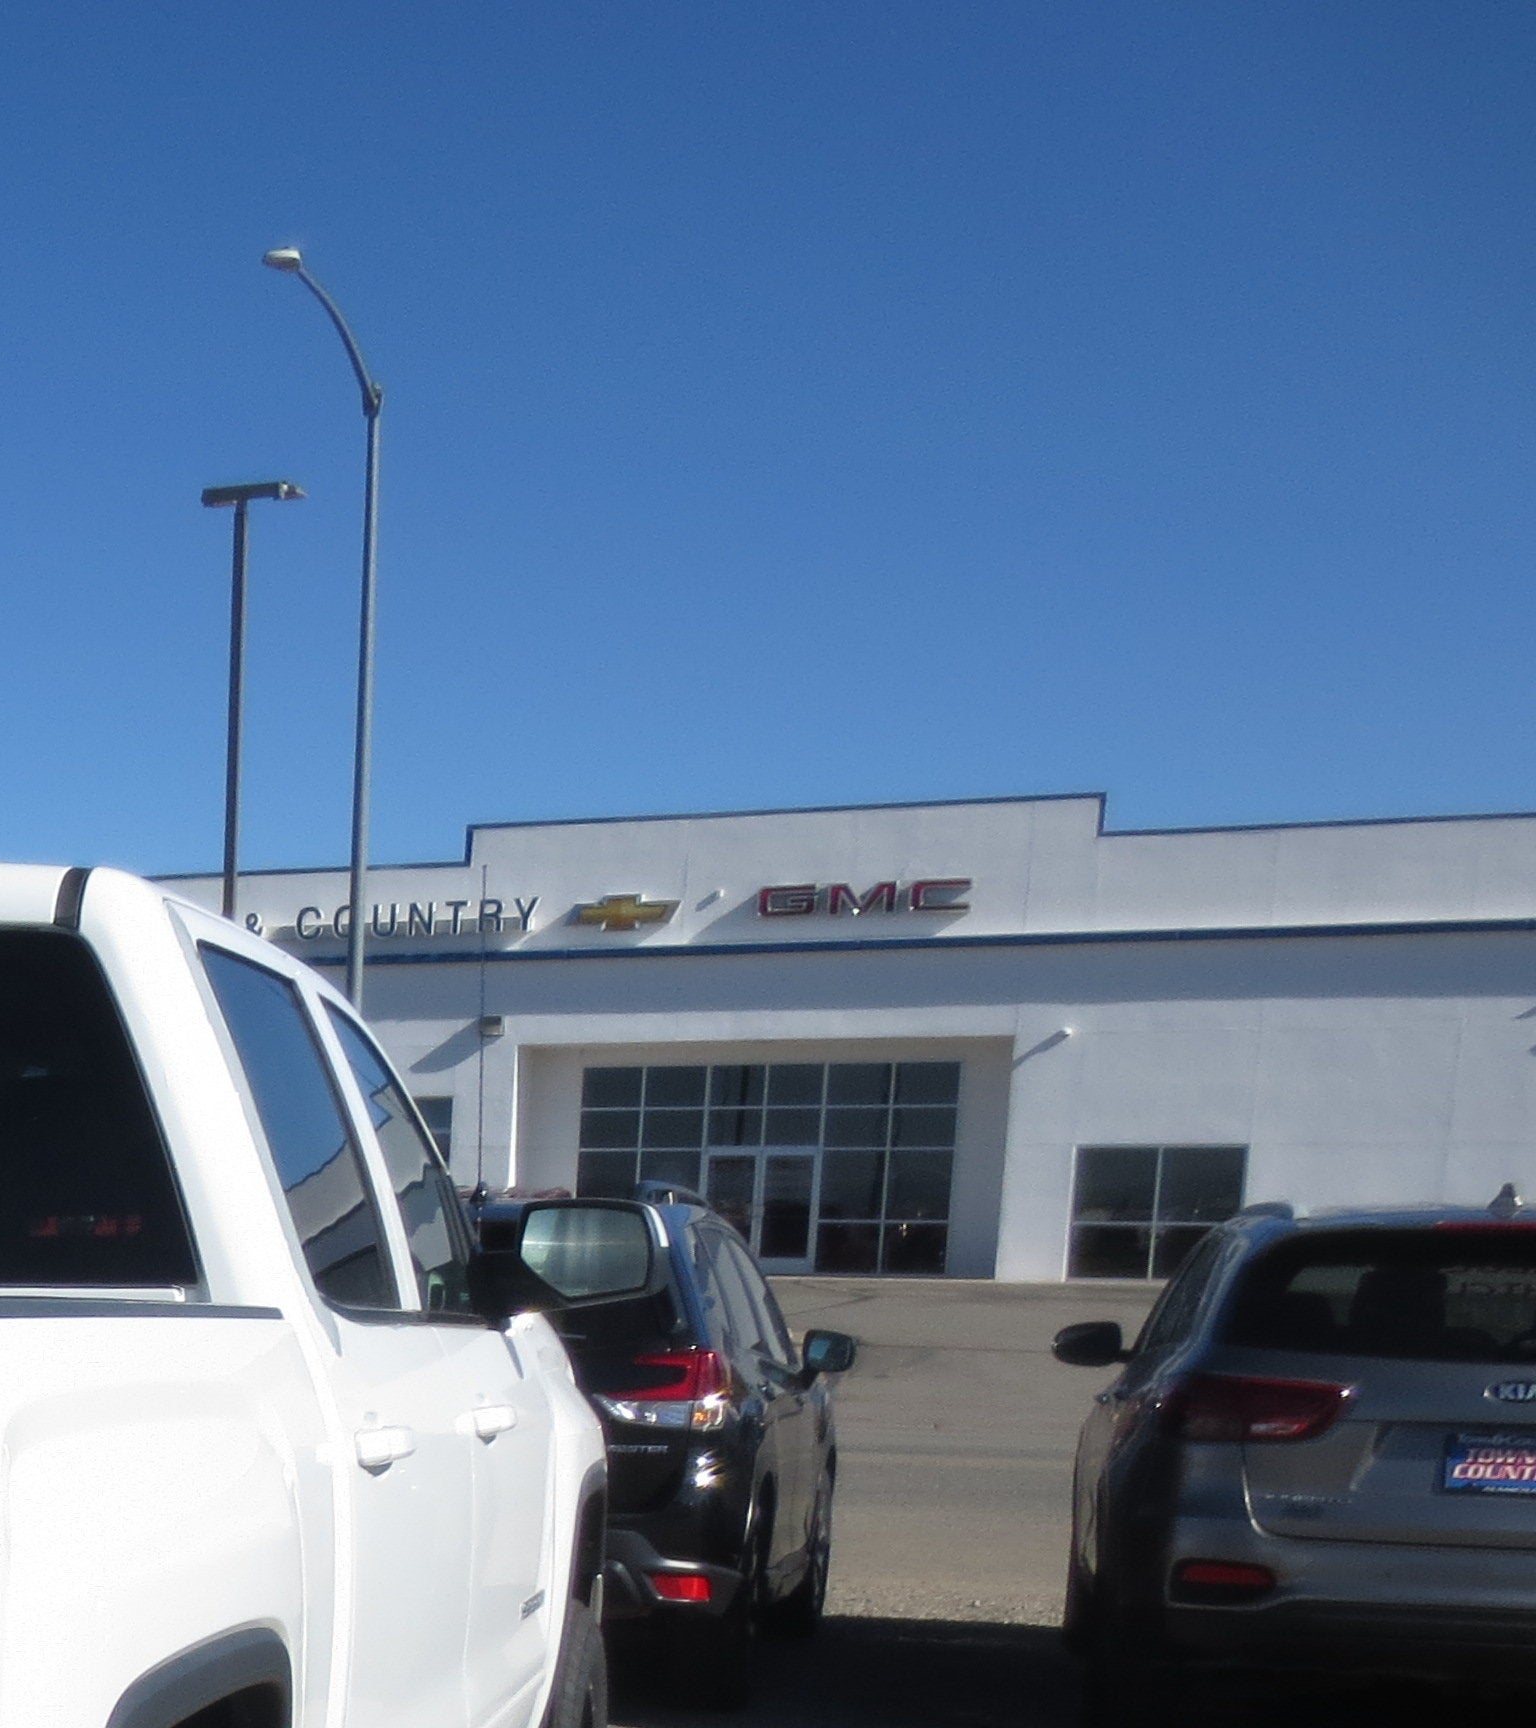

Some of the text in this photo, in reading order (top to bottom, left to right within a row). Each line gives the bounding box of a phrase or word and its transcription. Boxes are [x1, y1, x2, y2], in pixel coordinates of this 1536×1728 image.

[758, 878, 973, 917] GMC
[244, 896, 540, 941] & COUNTRY
[1452, 1462, 1536, 1480] COUNT
